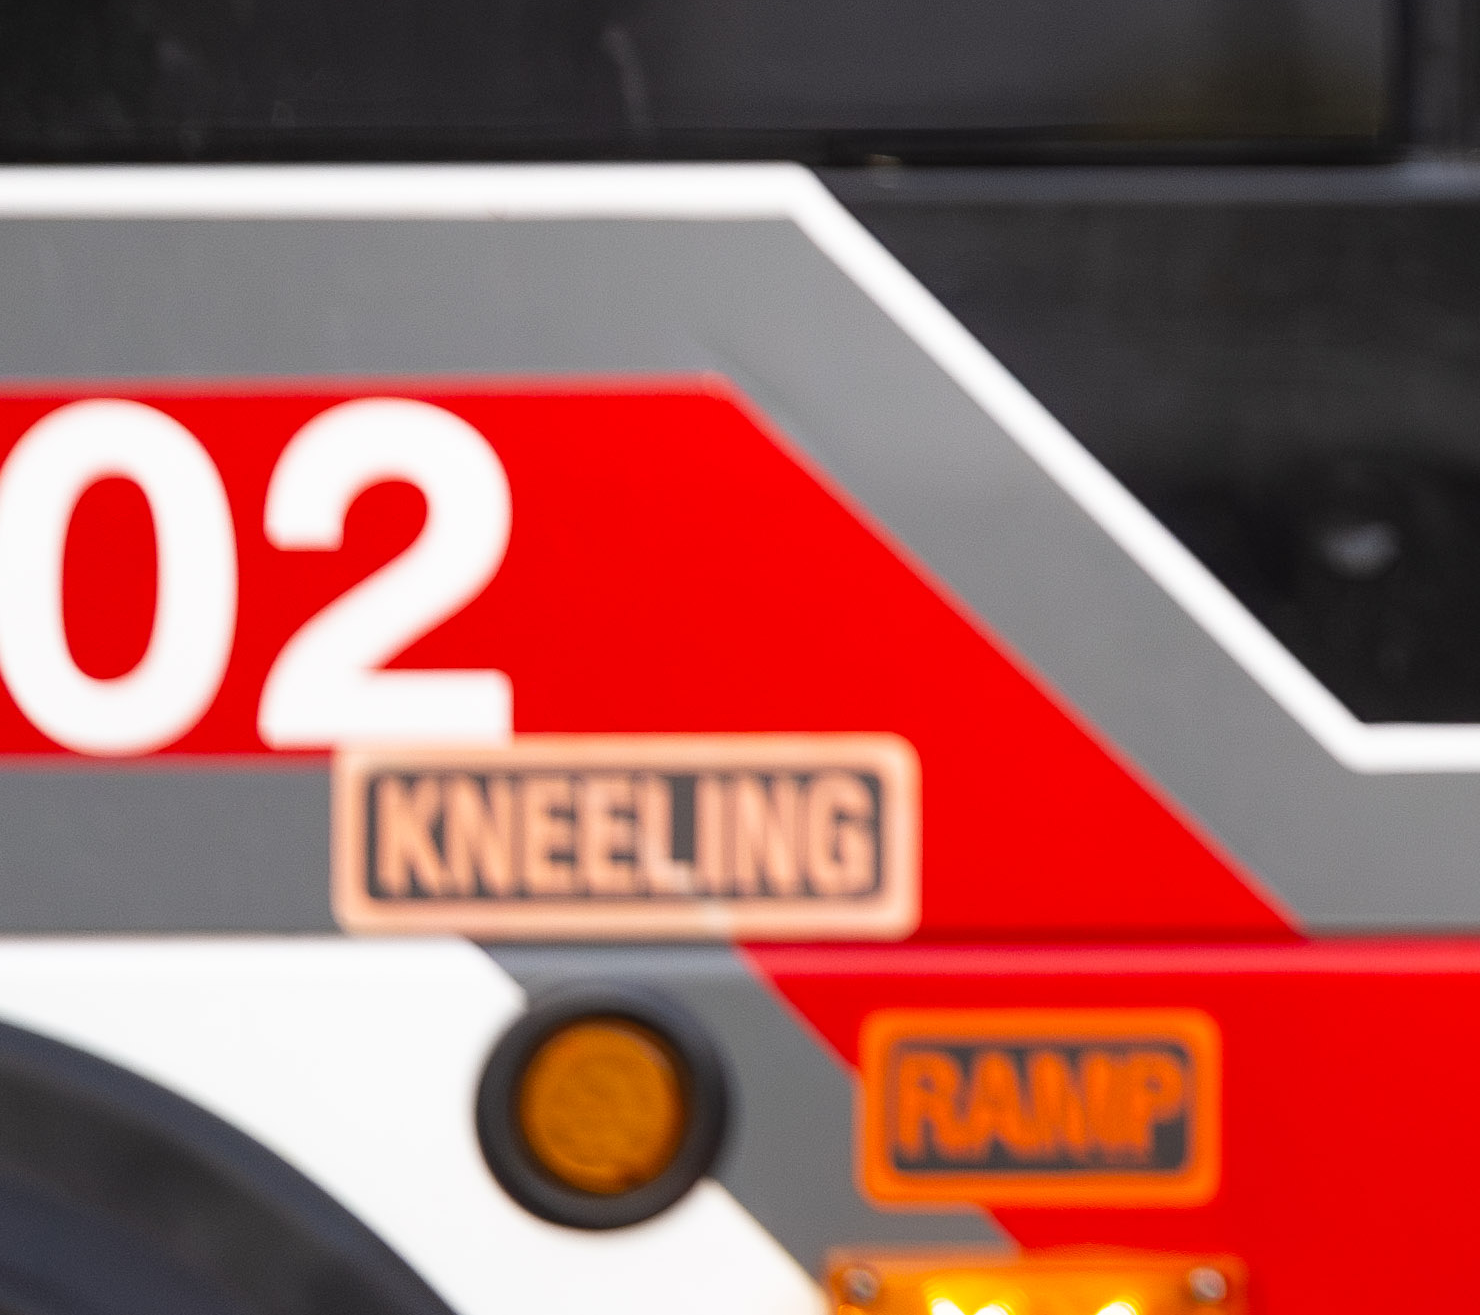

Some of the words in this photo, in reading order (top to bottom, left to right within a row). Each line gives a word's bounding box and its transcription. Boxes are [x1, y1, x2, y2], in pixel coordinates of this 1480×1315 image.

[0, 397, 514, 757] 02
[374, 772, 882, 895] KNEELING
[896, 1049, 1186, 1154] RAMP
